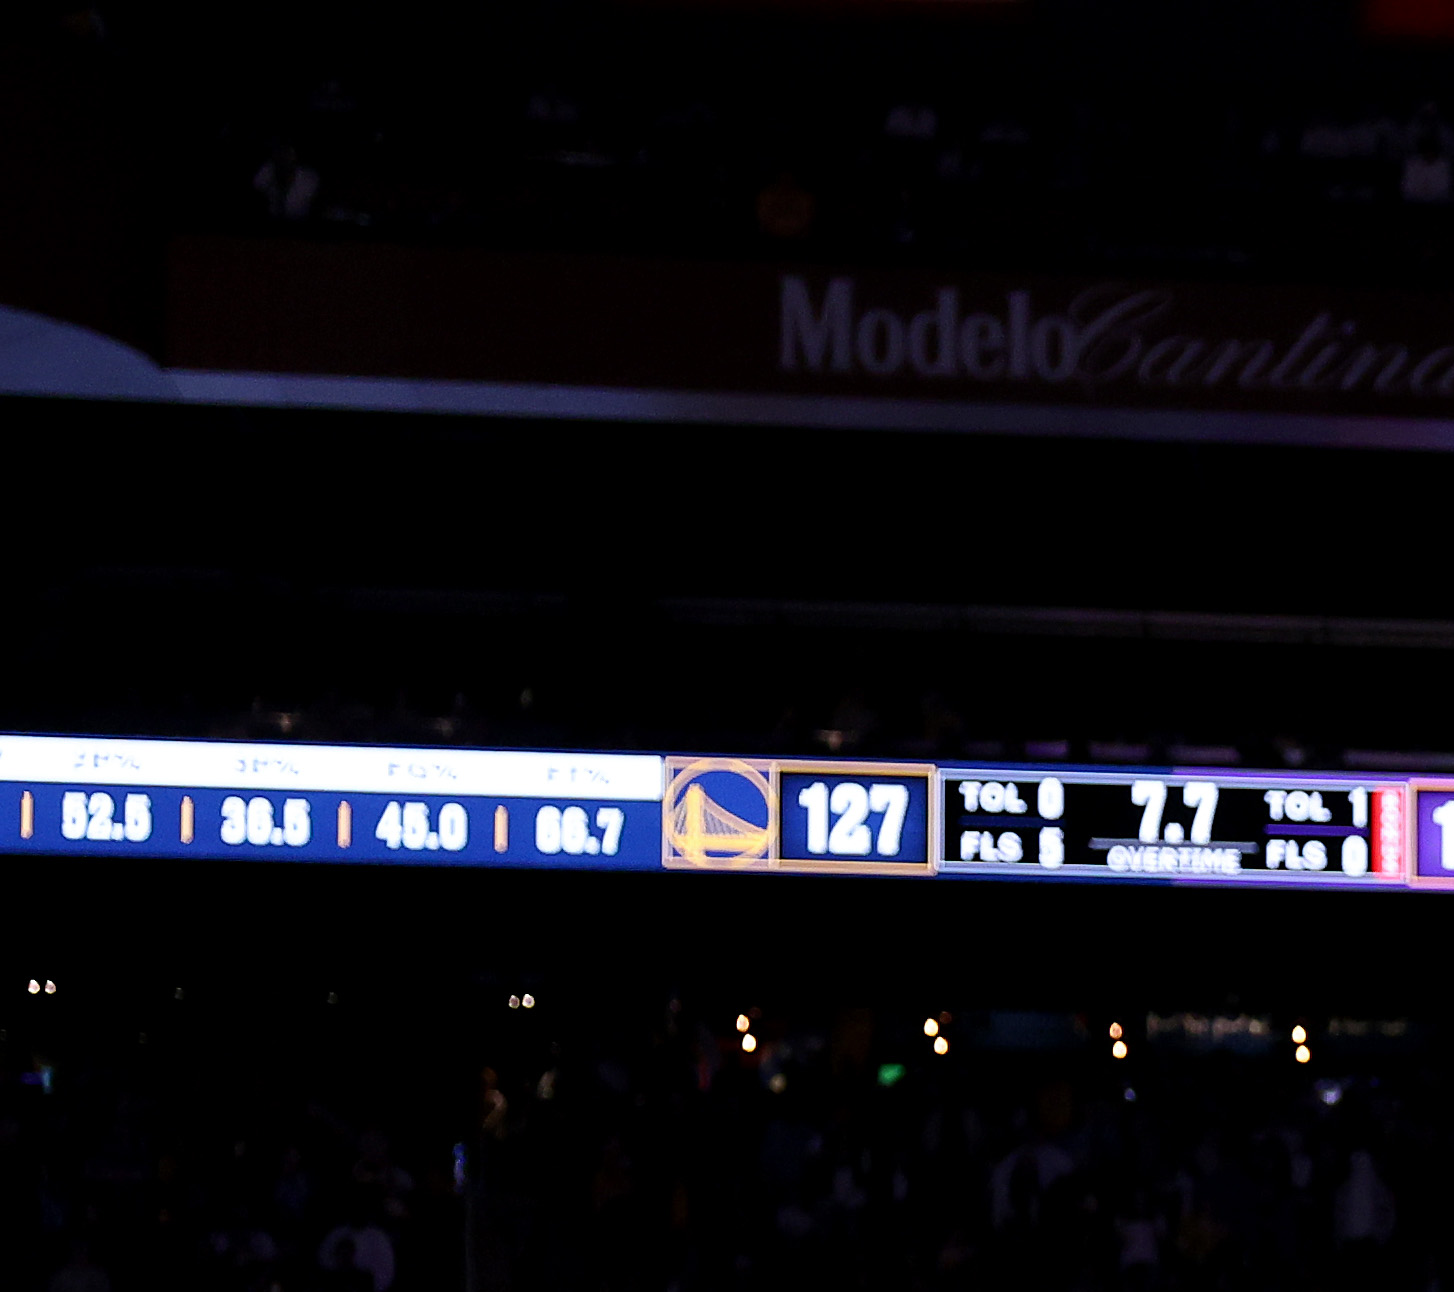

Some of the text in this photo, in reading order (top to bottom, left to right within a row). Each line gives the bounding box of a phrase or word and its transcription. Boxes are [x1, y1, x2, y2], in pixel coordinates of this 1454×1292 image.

[780, 274, 1079, 385] Modelo
[62, 791, 151, 841] 52.5
[375, 801, 467, 850] 45.0
[798, 782, 908, 855] 127
[958, 781, 1025, 813] TOL
[1131, 779, 1220, 845] 7.7
[1264, 785, 1367, 827] TOL 1
[960, 829, 1024, 863] FLS
[1264, 838, 1329, 871] FLS
